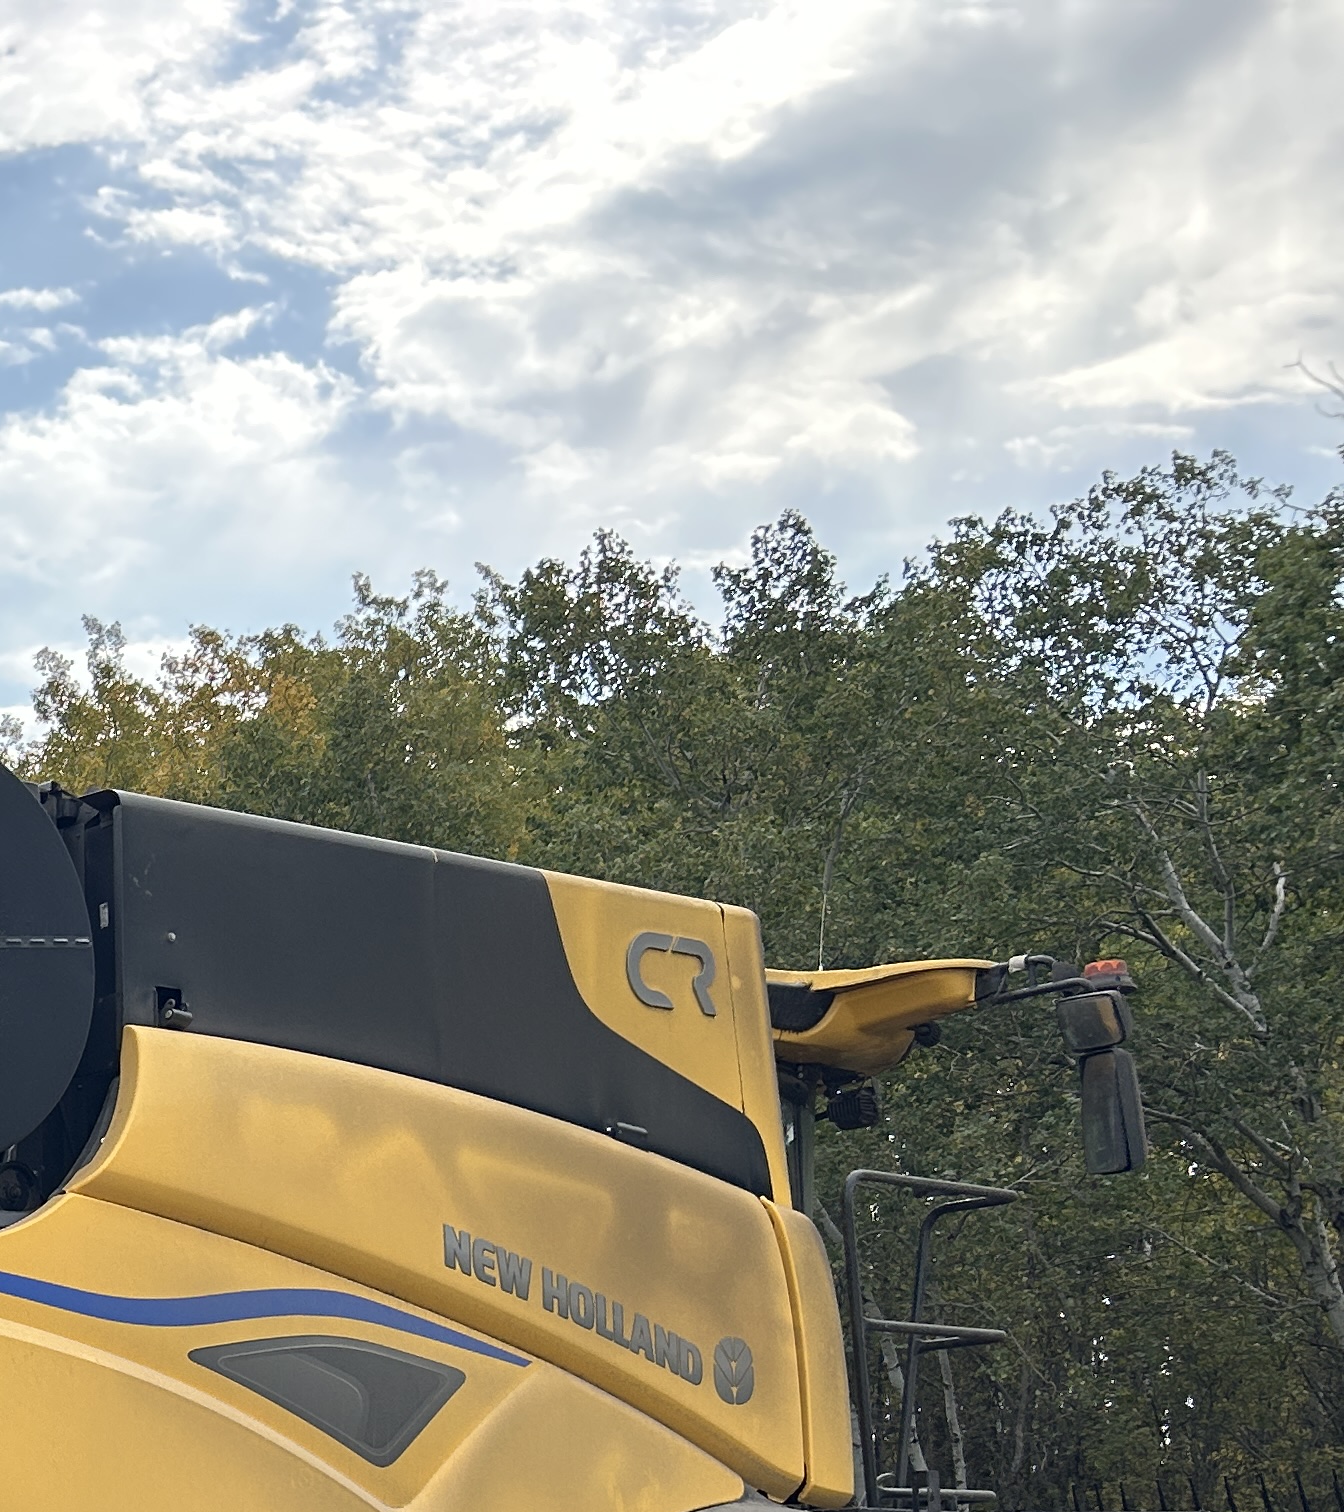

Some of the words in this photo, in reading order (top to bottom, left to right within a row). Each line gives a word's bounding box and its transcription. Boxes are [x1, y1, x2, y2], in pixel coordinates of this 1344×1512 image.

[626, 931, 716, 1017] CR
[442, 1223, 533, 1300] NEW
[542, 1266, 704, 1386] HOLLAND
